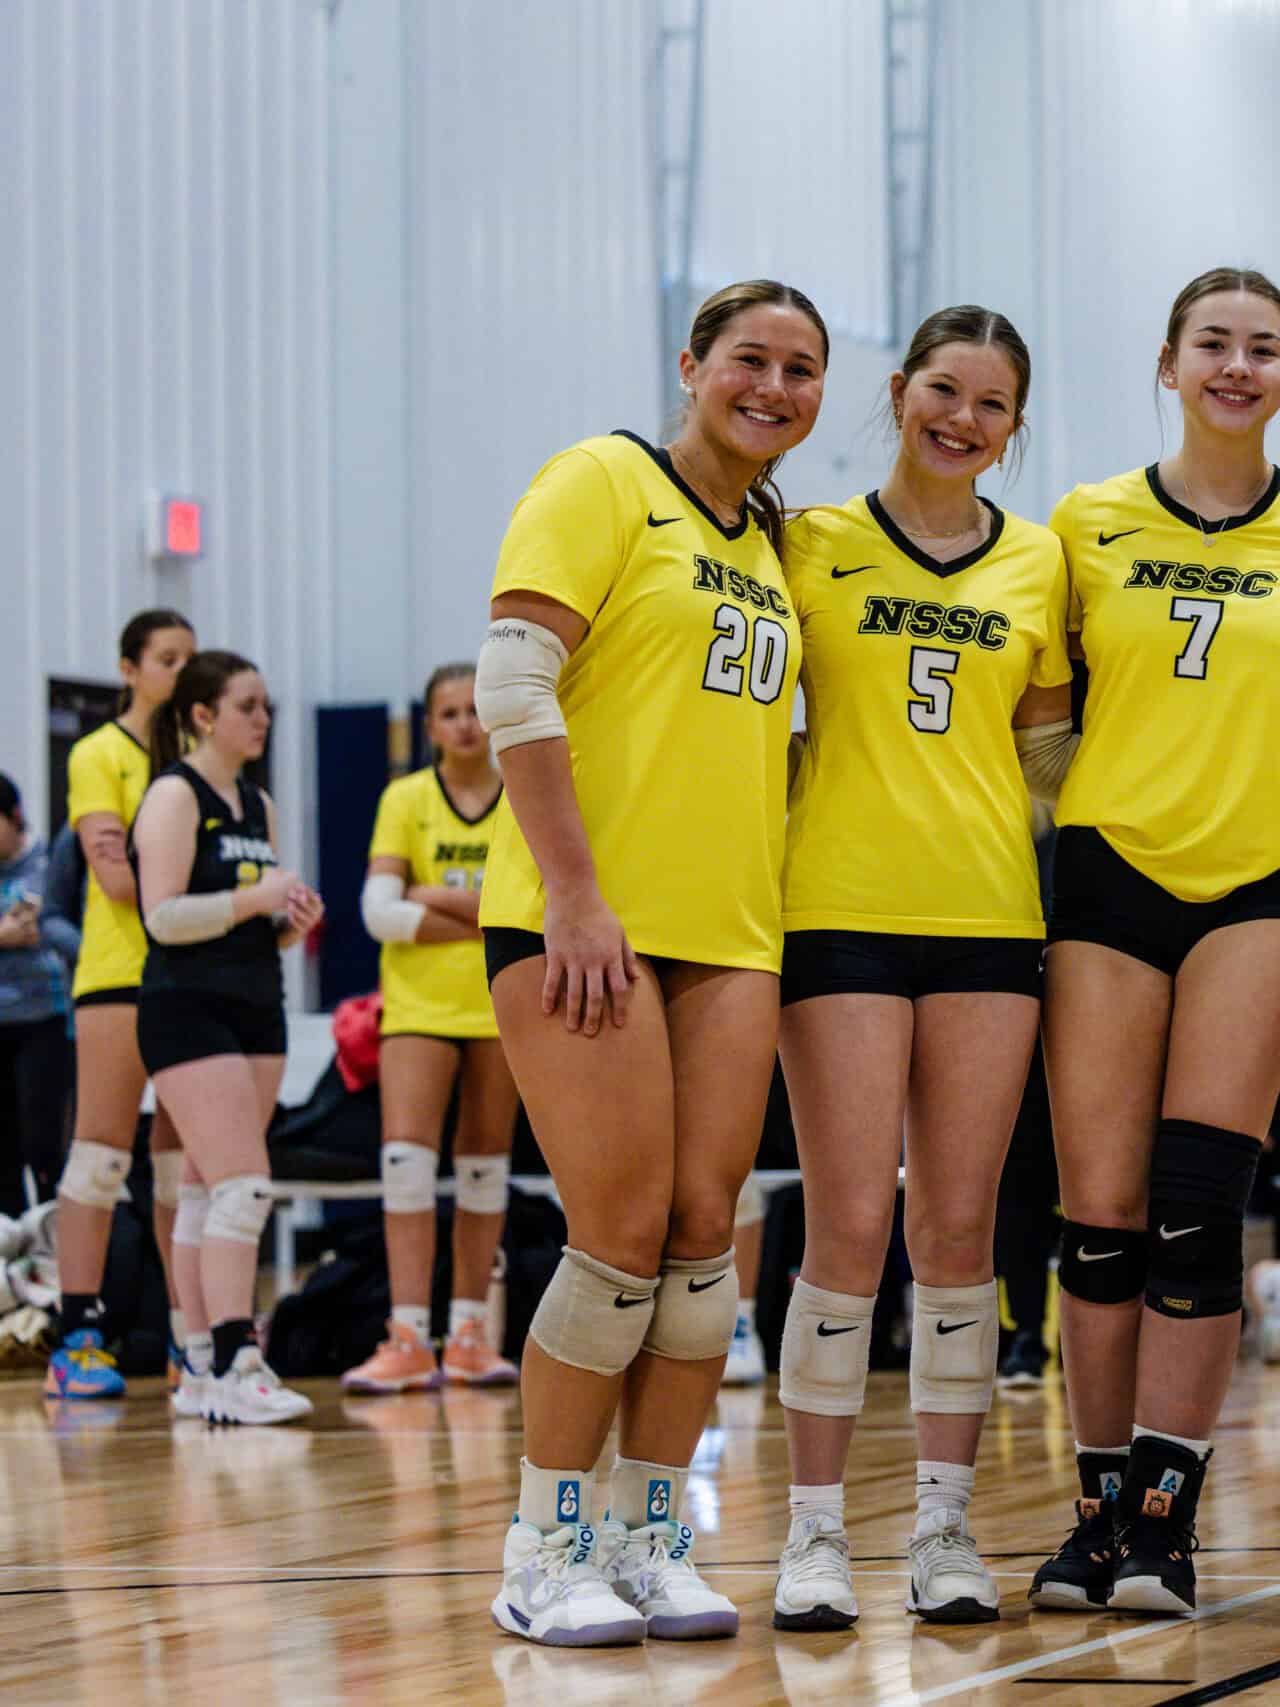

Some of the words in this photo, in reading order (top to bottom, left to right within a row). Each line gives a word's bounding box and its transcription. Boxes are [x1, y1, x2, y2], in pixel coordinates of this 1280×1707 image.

[693, 554, 790, 618] NSSC
[1124, 559, 1278, 598] NSSC
[702, 603, 788, 705] 20
[858, 595, 1011, 650] NSSC
[1170, 596, 1224, 680] 7
[908, 645, 960, 734] 5
